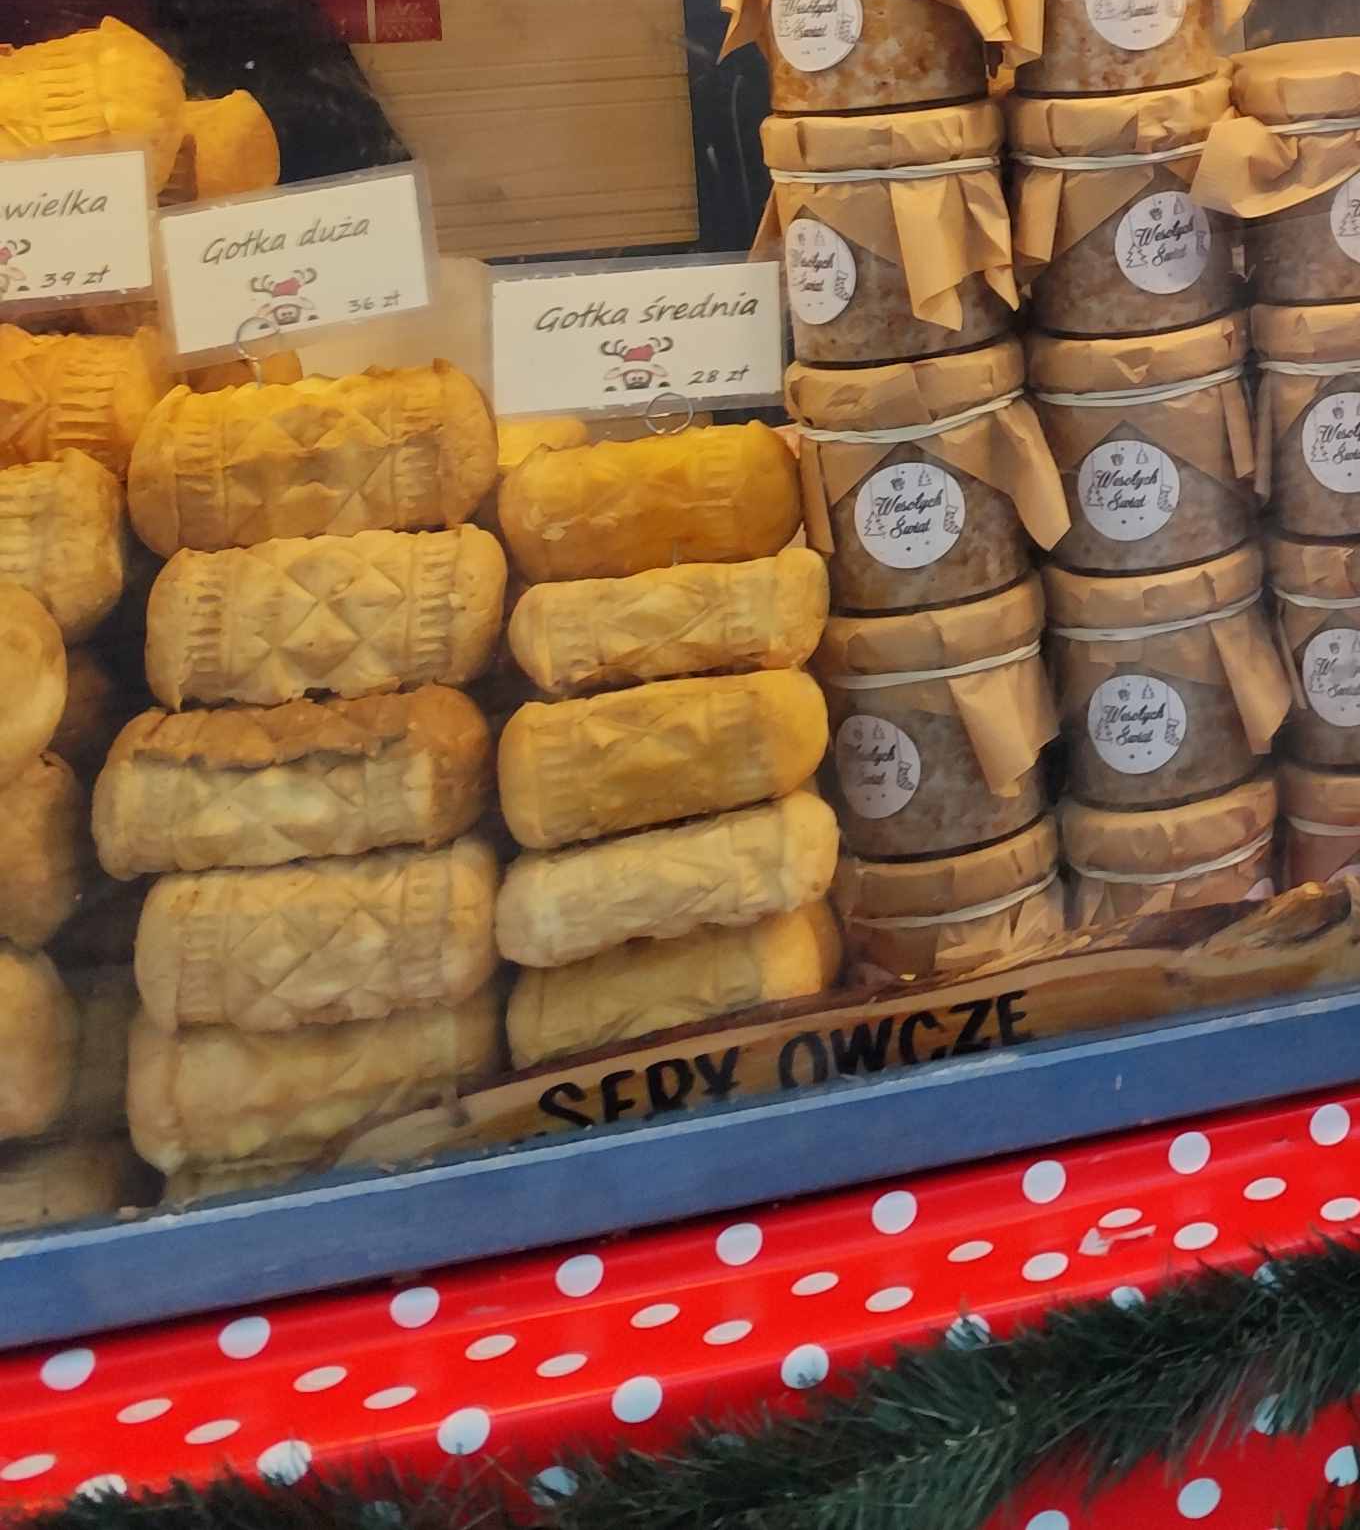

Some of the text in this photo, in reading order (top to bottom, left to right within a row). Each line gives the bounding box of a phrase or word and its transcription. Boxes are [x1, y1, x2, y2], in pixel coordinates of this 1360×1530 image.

[4, 188, 109, 221] wielka
[296, 216, 371, 247] duża
[40, 271, 76, 289] 39
[348, 297, 375, 314] 36
[638, 291, 760, 324] średnia
[687, 370, 719, 386] 28
[536, 988, 1034, 1134] SERY OWCZE
